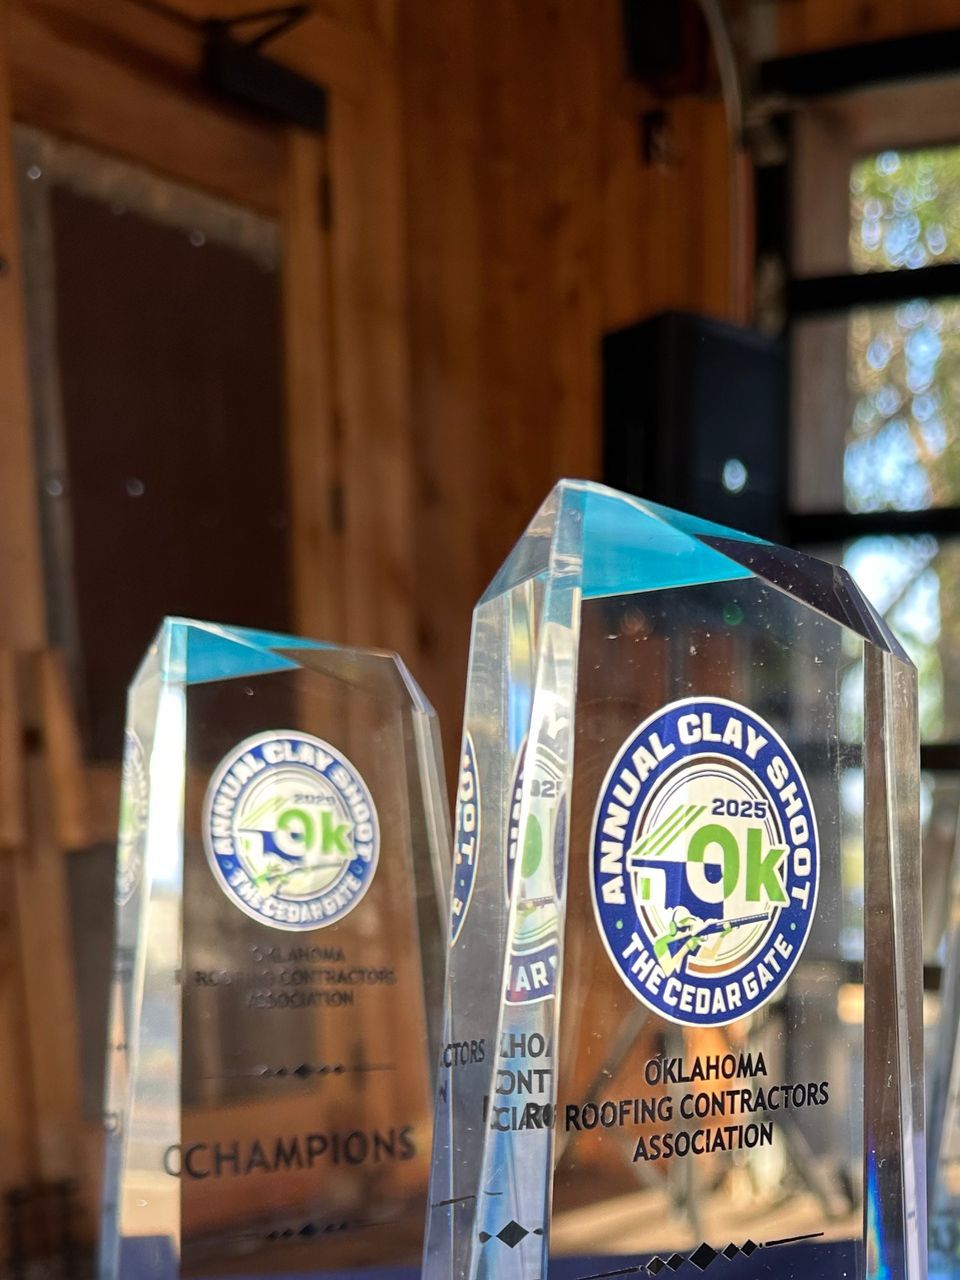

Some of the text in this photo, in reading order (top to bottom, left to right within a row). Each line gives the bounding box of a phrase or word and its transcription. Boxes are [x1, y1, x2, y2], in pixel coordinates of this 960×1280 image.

[210, 753, 265, 856] ANNUAL
[262, 740, 335, 771] CLAY
[600, 732, 676, 906] ANNUAL
[676, 712, 768, 760] CLAY
[766, 755, 812, 910] SHOOT
[711, 798, 768, 820] 2025
[621, 932, 669, 994] THE
[662, 977, 743, 1016] CEDAR
[740, 933, 794, 1001] GATE
[643, 1051, 768, 1086] OKLAHOMA
[565, 1095, 674, 1132] ROOFING
[679, 1081, 830, 1120] CONTRACTORS
[631, 1121, 774, 1162] ASSOCIATION
